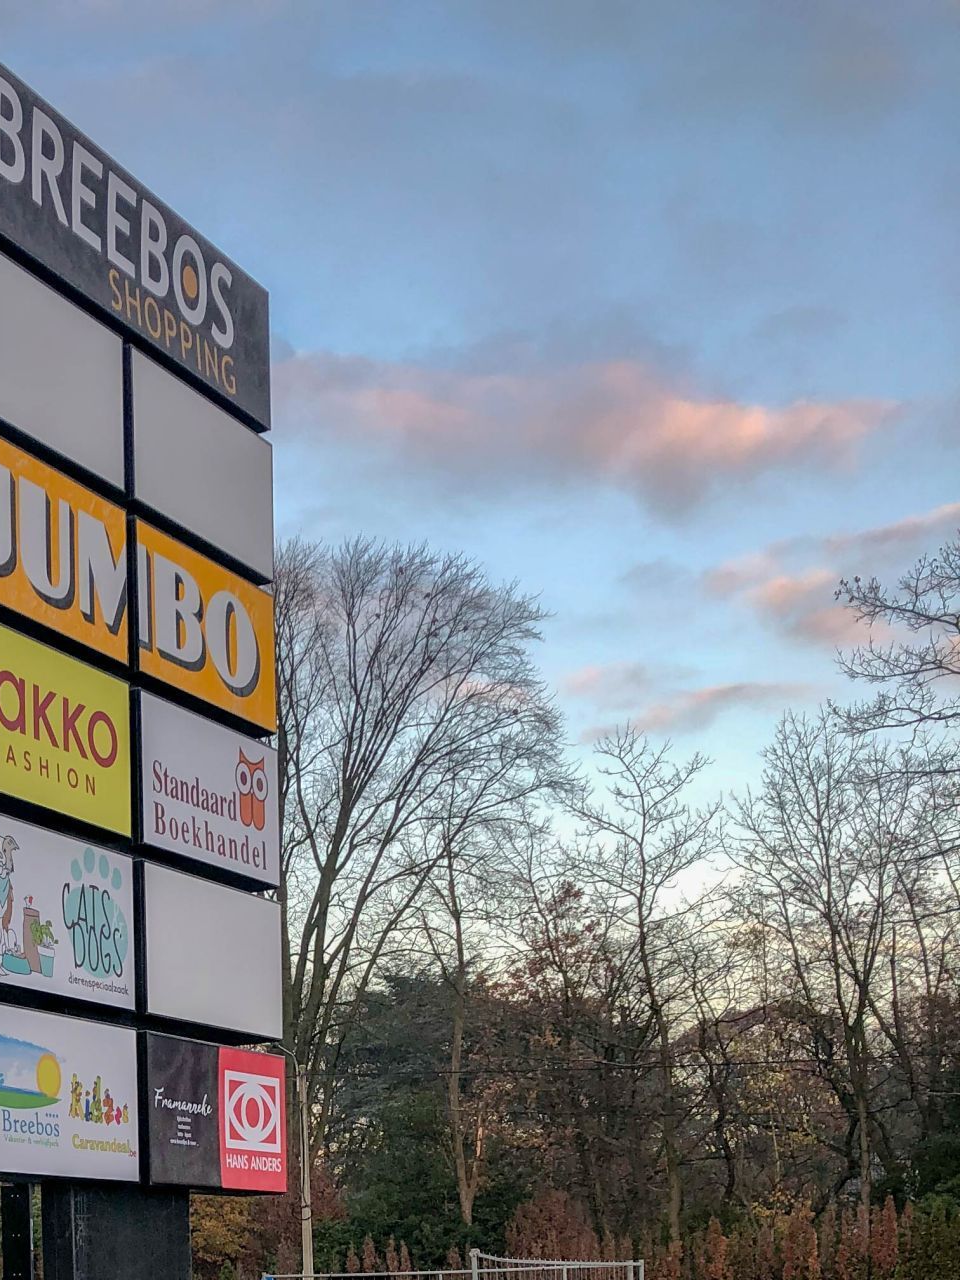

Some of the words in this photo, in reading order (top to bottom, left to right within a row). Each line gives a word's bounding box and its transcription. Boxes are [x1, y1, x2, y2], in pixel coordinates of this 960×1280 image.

[108, 268, 237, 395] SHOPPING
[152, 759, 238, 822] Standaard
[153, 800, 267, 871] Boekhandel
[62, 882, 112, 941] CATS
[71, 918, 123, 978] DOGS
[1, 1108, 60, 1138] Breebos
[225, 1153, 249, 1170] HANS
[250, 1155, 282, 1173] ANDERS
